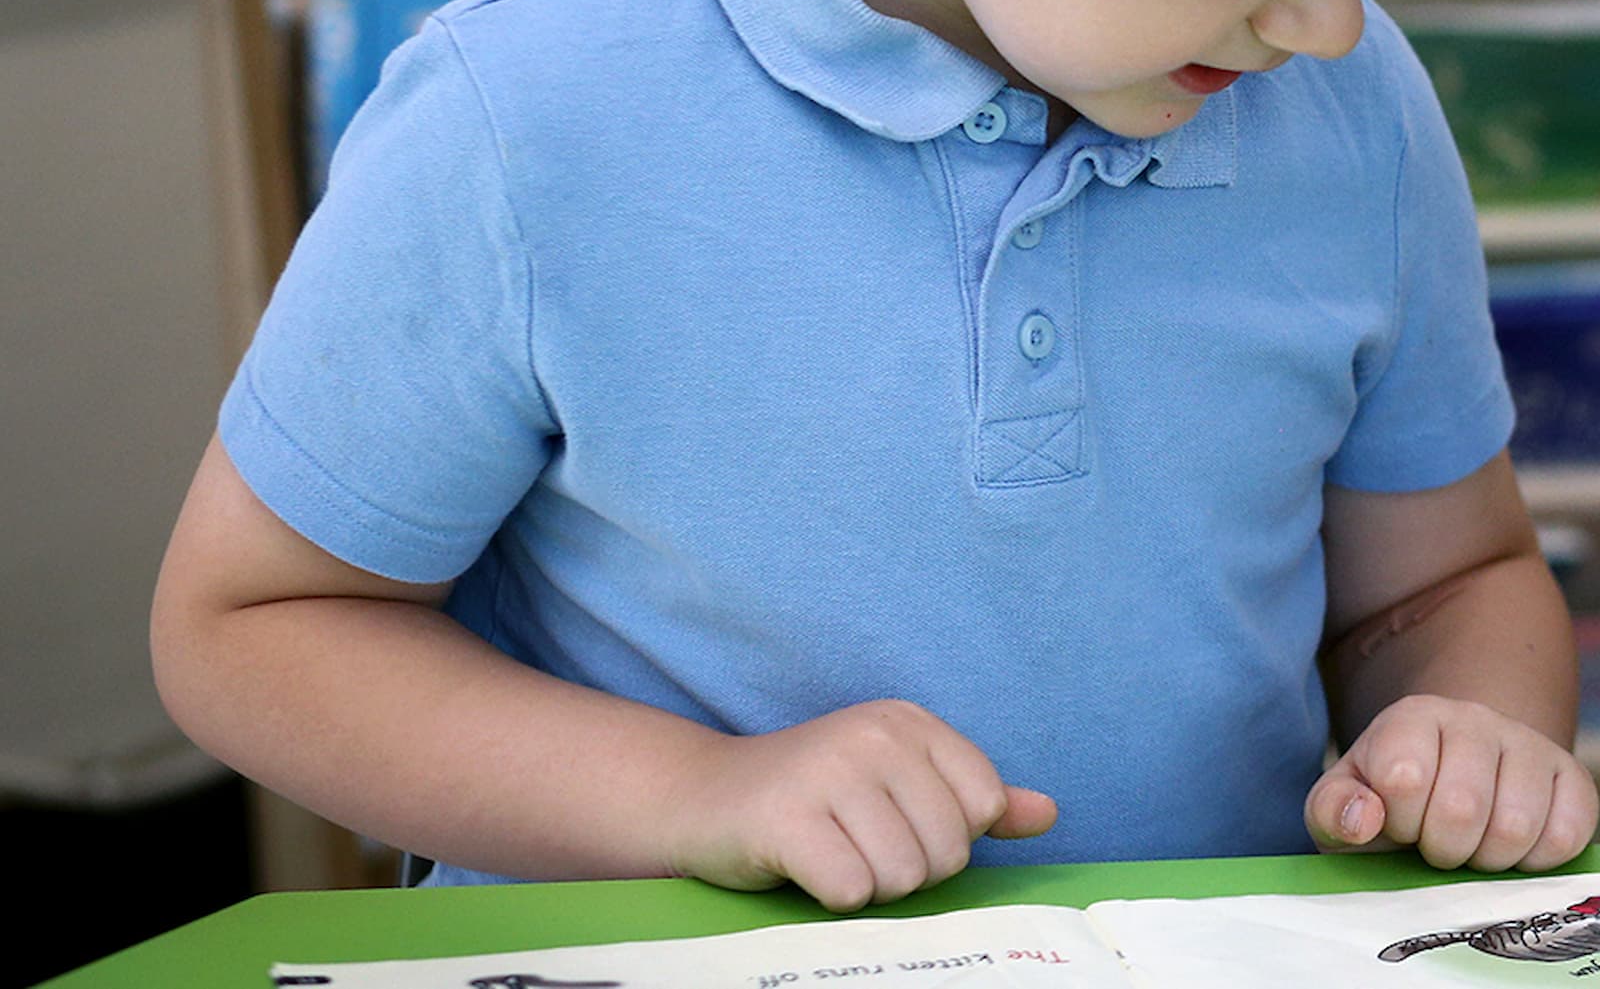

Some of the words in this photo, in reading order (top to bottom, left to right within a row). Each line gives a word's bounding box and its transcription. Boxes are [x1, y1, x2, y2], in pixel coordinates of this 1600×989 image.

[897, 953, 995, 971] kitten
[1006, 949, 1072, 964] The
[812, 964, 885, 980] runs
